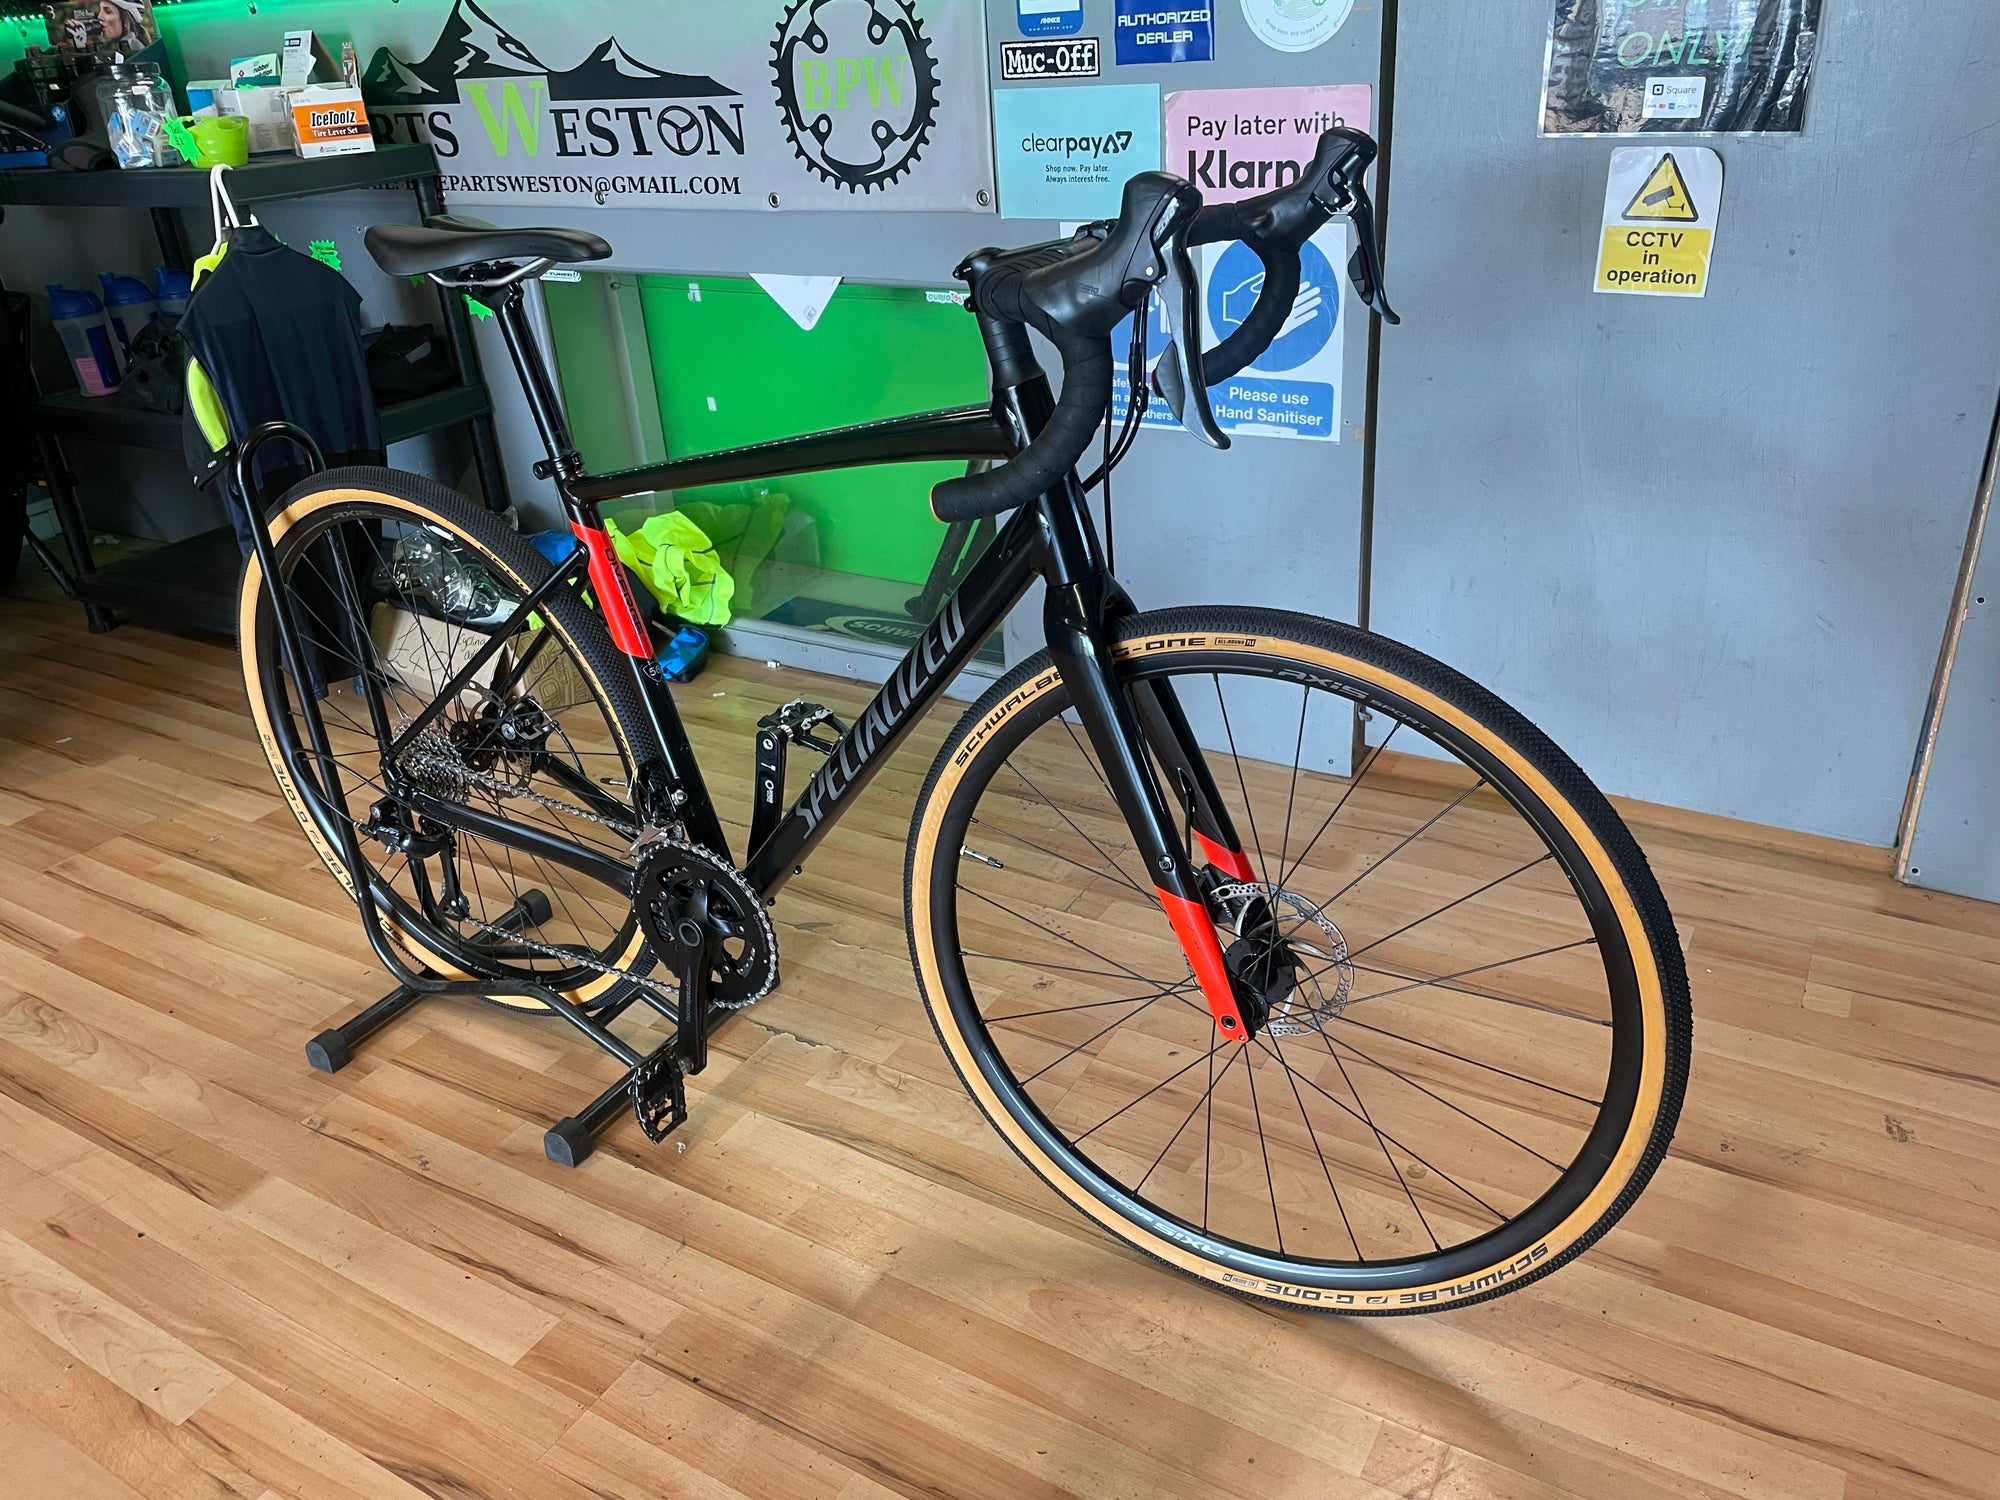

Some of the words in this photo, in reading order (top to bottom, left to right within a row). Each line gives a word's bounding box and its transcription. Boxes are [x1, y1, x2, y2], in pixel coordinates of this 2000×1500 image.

[1117, 8, 1211, 28] AUTHORIZED
[1136, 29, 1193, 46] DEALER
[1617, 29, 1752, 67] ONLY!
[1006, 44, 1094, 74] Muc-Off
[797, 54, 908, 111] BPW
[1666, 86, 1697, 95] Square
[311, 109, 356, 128] IceToolz
[462, 80, 746, 159] WESTON
[1188, 115, 1227, 141] Pay
[1234, 113, 1287, 135] later
[1294, 110, 1346, 134] with
[313, 129, 326, 138] Tire
[327, 127, 346, 137] Lever
[347, 126, 359, 136] Set
[1021, 132, 1103, 159] clearpay
[1045, 164, 1061, 173] Shop
[1063, 165, 1078, 173] now.
[1079, 164, 1091, 174] Pay
[1092, 163, 1110, 173] later.
[1045, 175, 1068, 184] Always
[1625, 231, 1684, 249] CCTV
[1642, 249, 1660, 266] in
[1606, 268, 1697, 286] operation
[1228, 385, 1279, 403] Please
[1281, 391, 1310, 406] use
[1215, 404, 1251, 421] Hand
[1254, 408, 1324, 427] Sanitiser
[604, 547, 644, 634] DIVERGE
[849, 619, 922, 641] SCHWA
[1112, 636, 1207, 658] G-ONE
[1277, 668, 1370, 700] AXIS
[1370, 698, 1432, 730] SPORT
[795, 590, 966, 840] SPECIALIZED
[1152, 1222, 1226, 1258] AXIS
[1400, 1242, 1549, 1304] SCHWALBE
[1264, 1282, 1354, 1305] G-ONE
